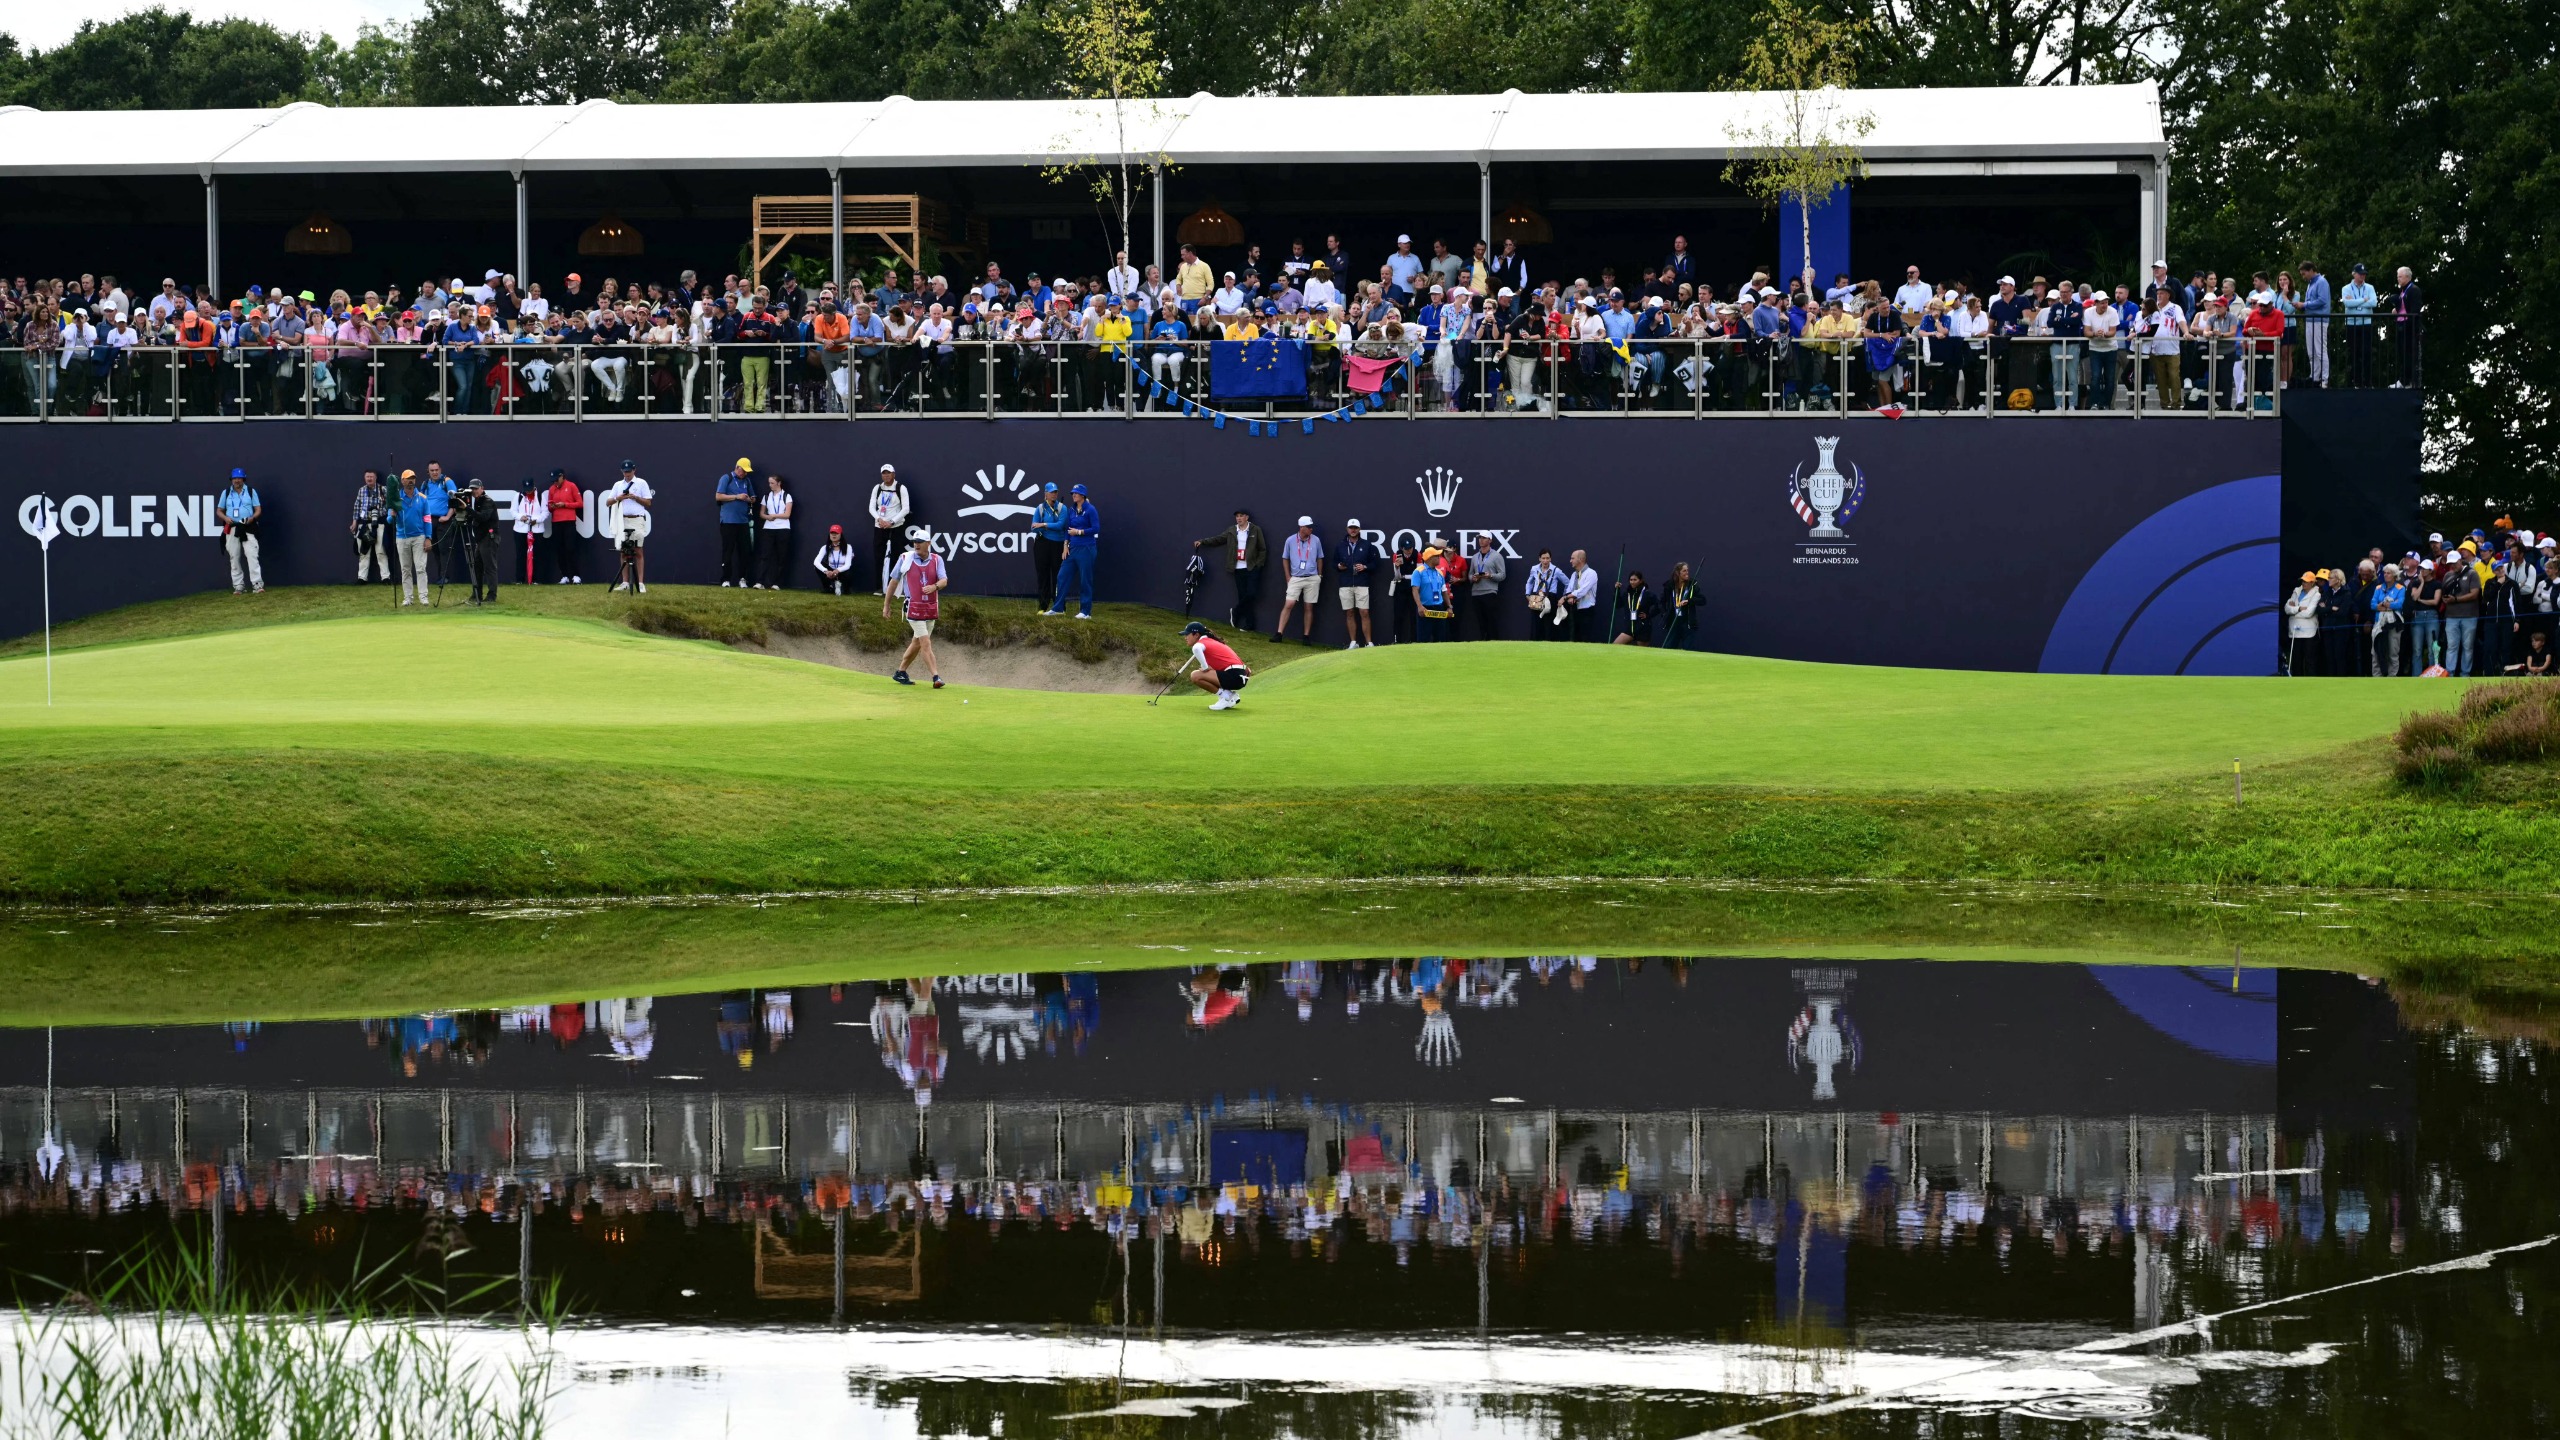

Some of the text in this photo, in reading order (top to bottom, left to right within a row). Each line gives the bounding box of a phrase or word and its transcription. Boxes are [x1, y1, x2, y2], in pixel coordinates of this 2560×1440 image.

[1800, 478, 1853, 489] SOLHEIM
[1814, 489, 1838, 499] CUP
[18, 494, 224, 537] GOLF.NL
[905, 525, 1098, 561] Skyscan
[1793, 557, 1859, 565] NETHERLANDS 2026
